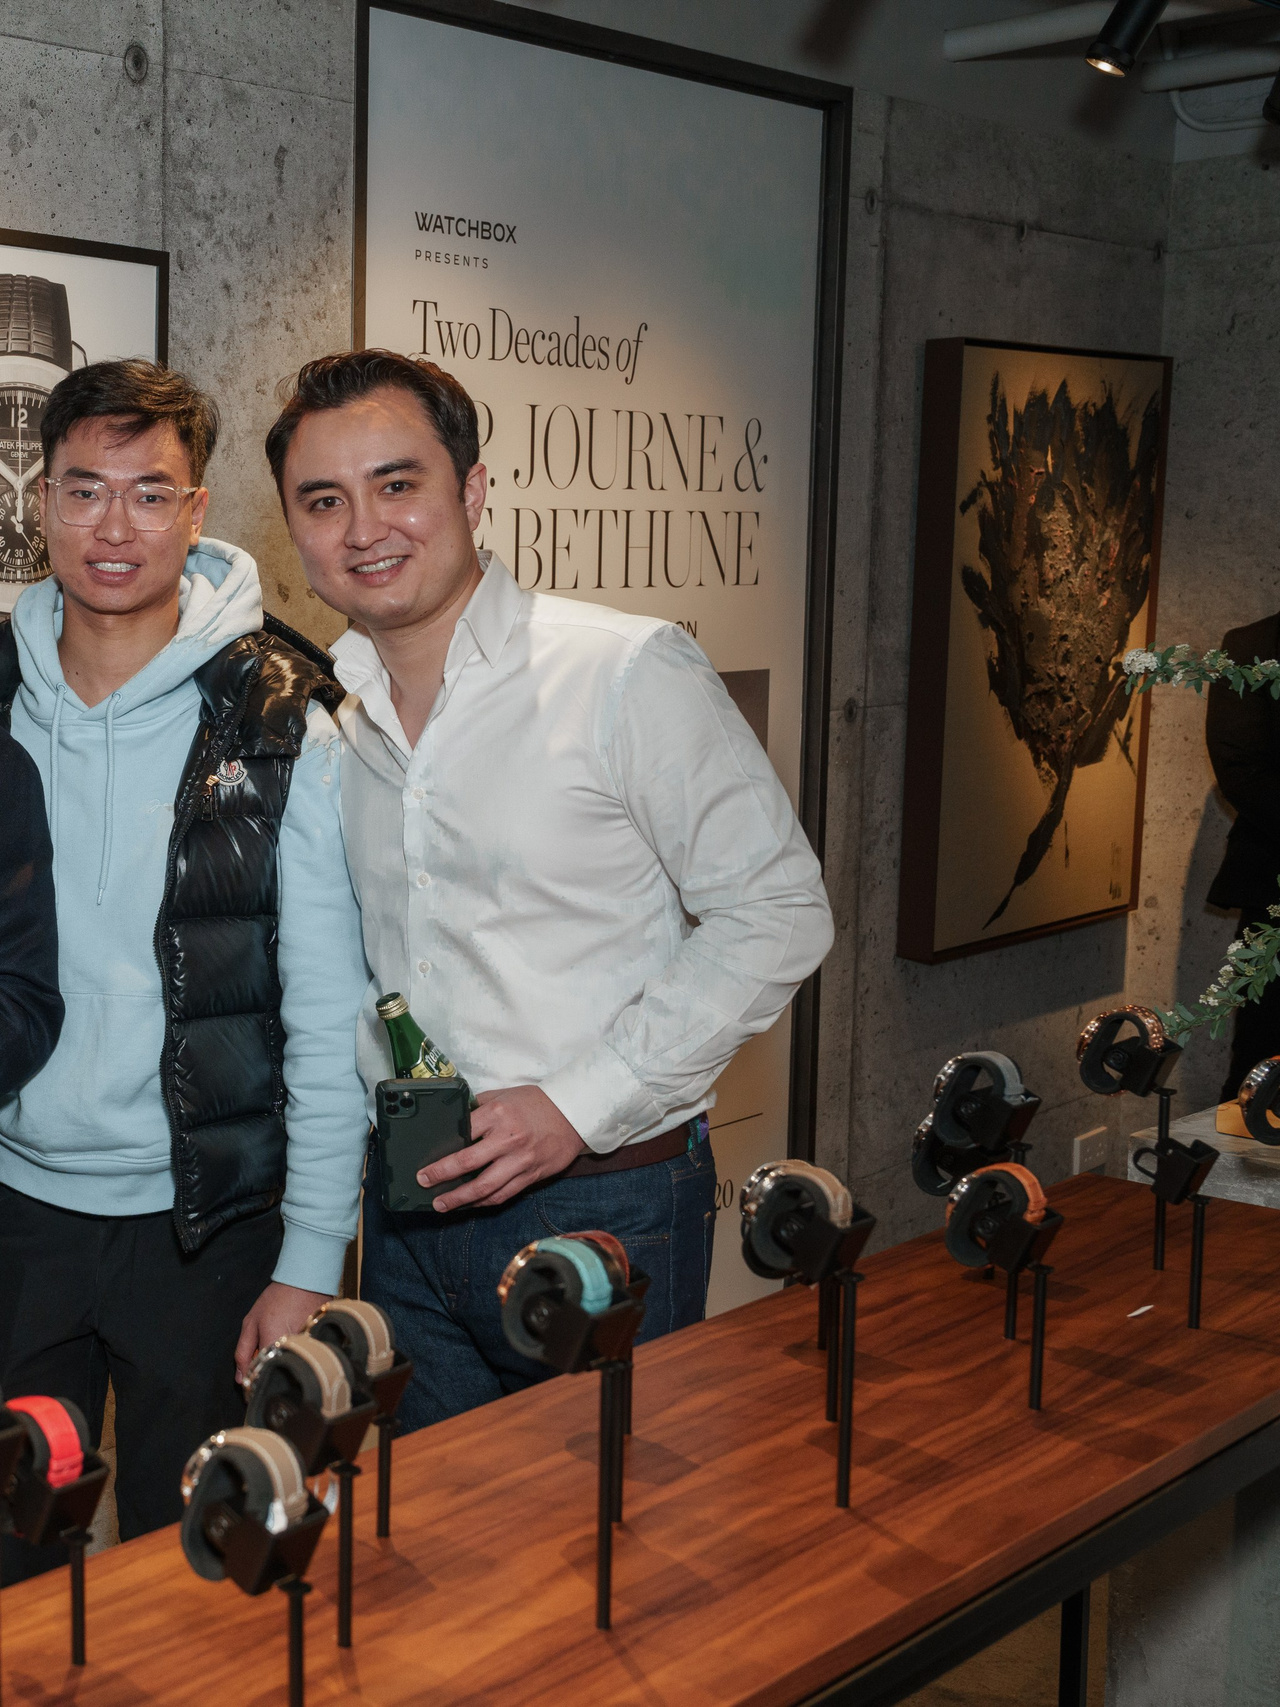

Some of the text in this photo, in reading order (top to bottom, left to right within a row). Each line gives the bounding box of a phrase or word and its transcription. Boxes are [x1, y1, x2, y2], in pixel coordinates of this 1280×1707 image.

[415, 211, 517, 244] WATCHBOX
[415, 249, 489, 269] PRESENTS
[412, 299, 648, 385] Two Decades of
[11, 407, 29, 429] 12
[513, 404, 724, 492] JOURNE
[733, 418, 768, 493] &
[510, 508, 760, 590] BETHUNE
